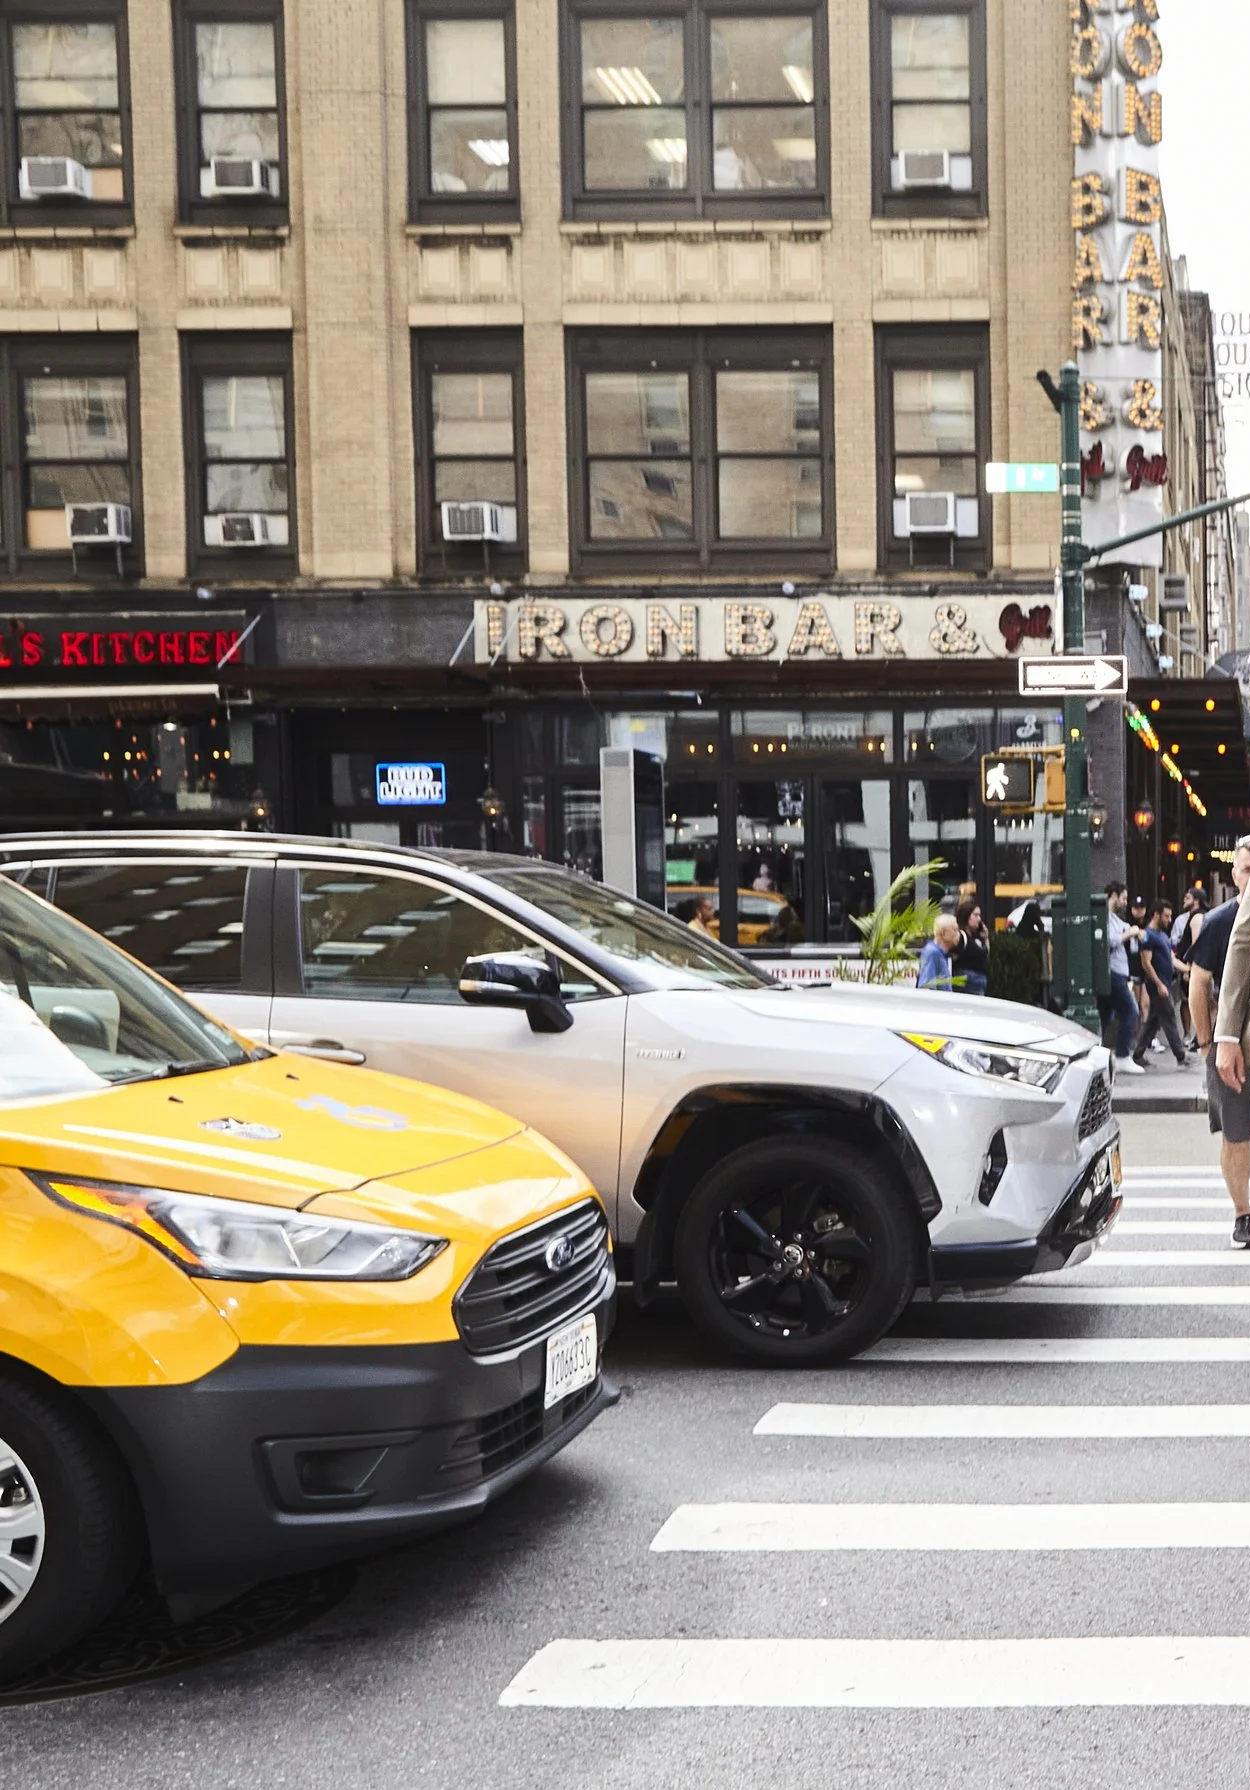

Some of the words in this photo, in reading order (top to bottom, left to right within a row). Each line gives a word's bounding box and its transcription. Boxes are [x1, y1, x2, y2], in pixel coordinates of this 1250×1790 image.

[1070, 172, 1105, 347] BAR
[1125, 166, 1164, 347] BAR
[1127, 378, 1165, 430] &
[60, 632, 242, 666] KITCHEN
[487, 603, 700, 658] IRON
[724, 602, 906, 657] BAR
[929, 602, 980, 653] &
[388, 765, 433, 783] BUD
[791, 967, 821, 978] FIFTH
